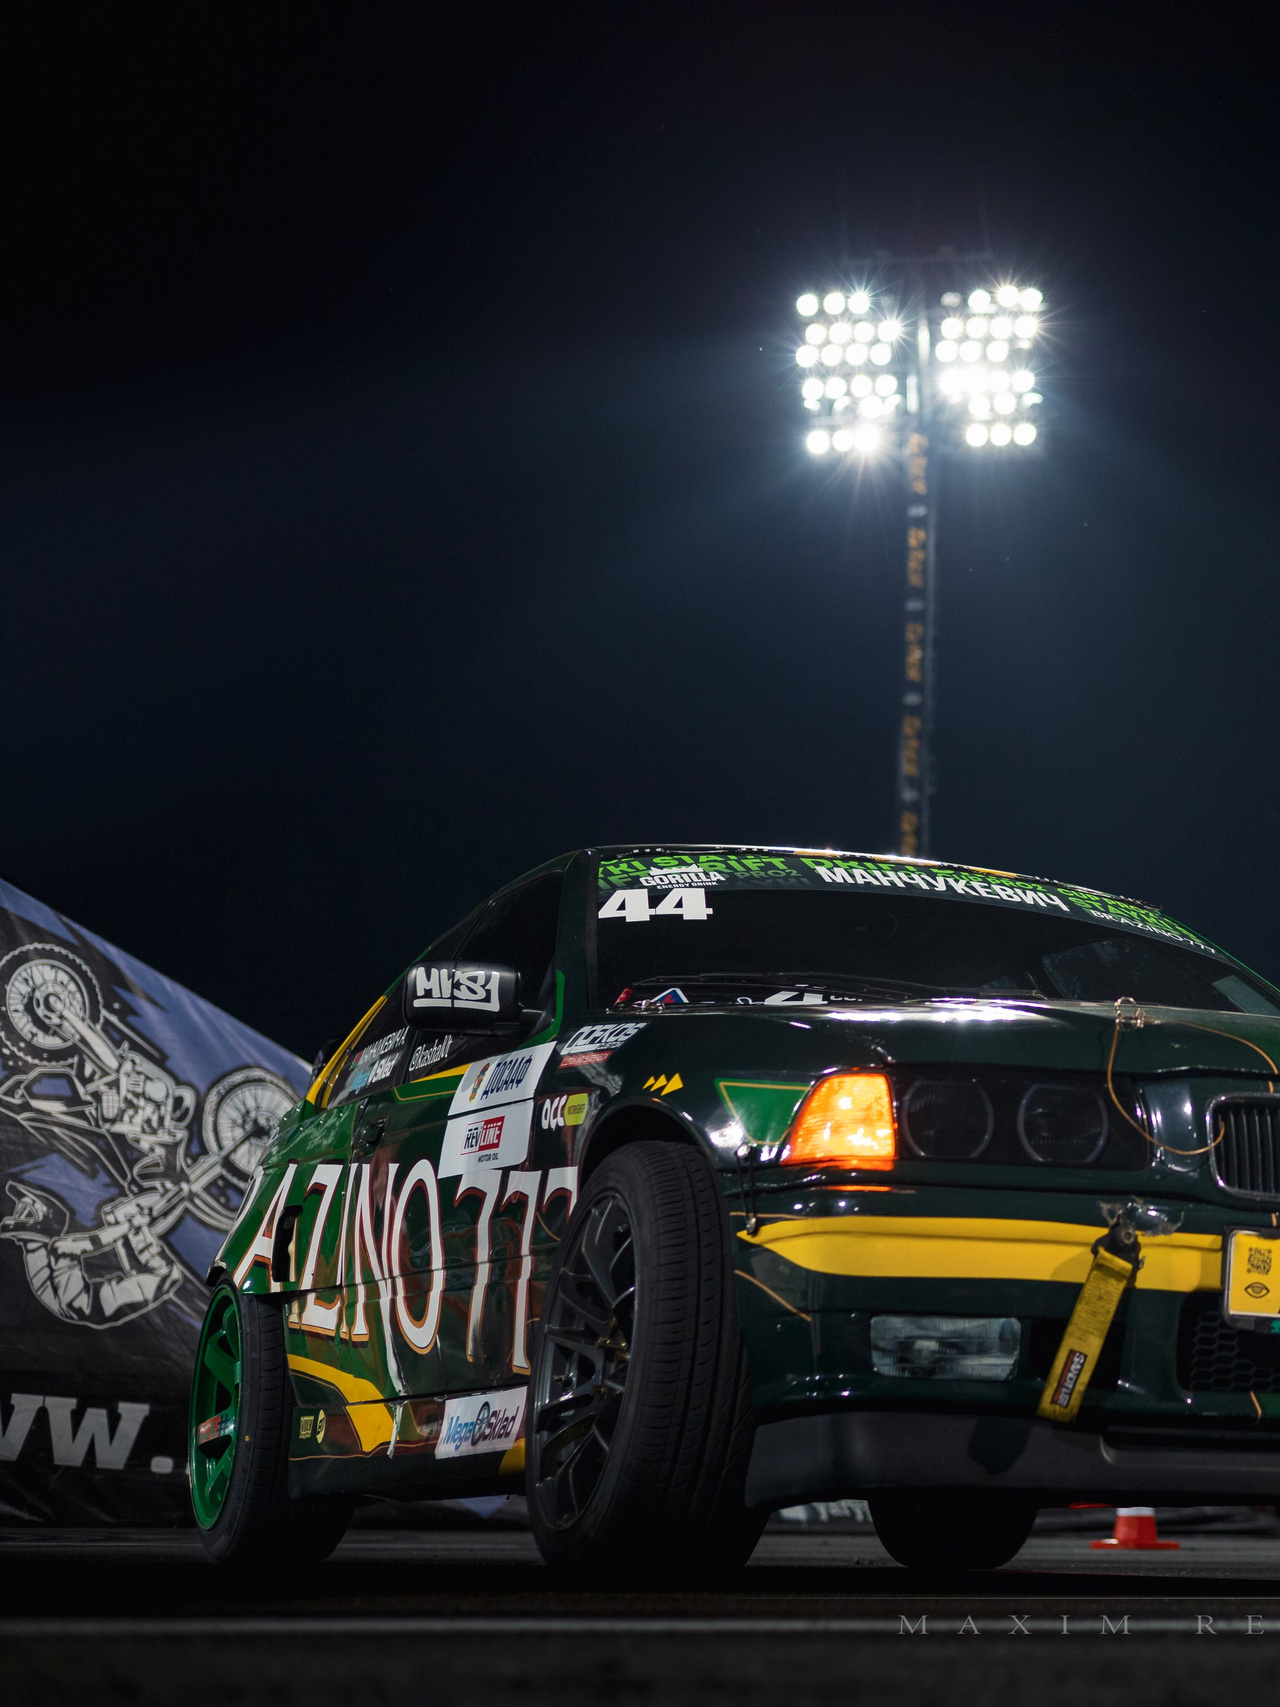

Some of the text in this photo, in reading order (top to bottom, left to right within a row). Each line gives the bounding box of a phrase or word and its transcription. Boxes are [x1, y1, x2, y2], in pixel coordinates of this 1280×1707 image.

[639, 871, 727, 887] GORILLA
[815, 866, 1070, 912] МАНЧУКЕВИЧ
[598, 888, 713, 922] 44
[480, 1054, 533, 1101] ДОСААФ
